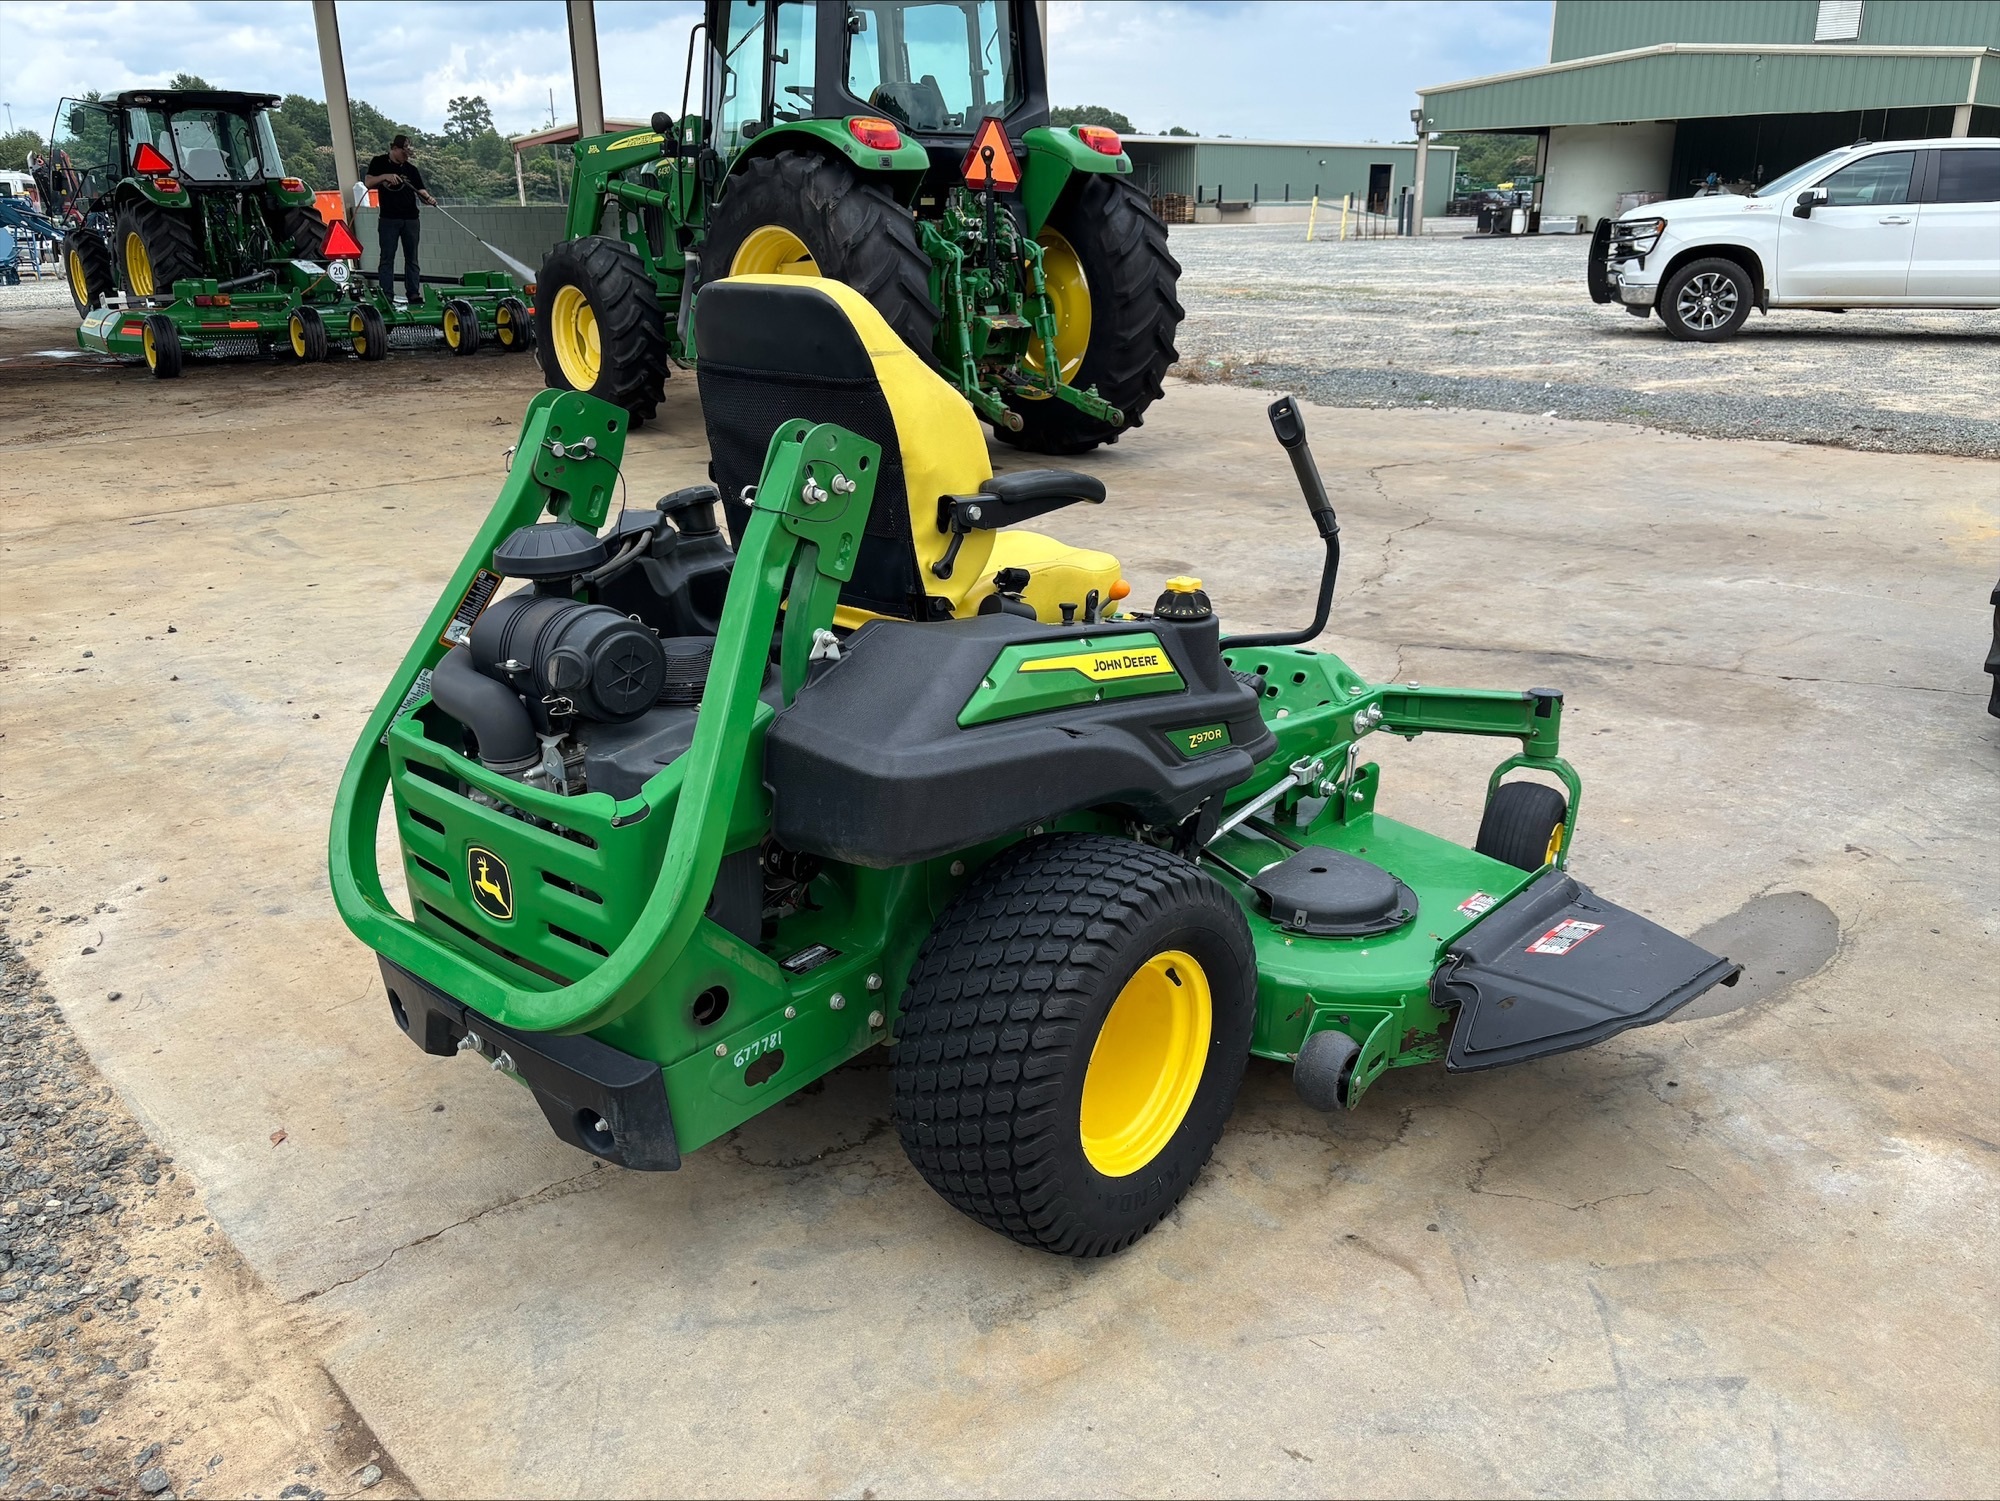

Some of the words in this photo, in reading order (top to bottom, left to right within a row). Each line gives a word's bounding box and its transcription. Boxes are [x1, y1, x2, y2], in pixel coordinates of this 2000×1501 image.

[657, 165, 671, 177] 6430
[333, 266, 344, 276] 20
[1093, 659, 1122, 672] JOHN
[1123, 655, 1159, 668] DEERE
[1188, 729, 1222, 749] Z970R
[733, 1030, 782, 1068] 677781
[1104, 1159, 1182, 1214] KENDA
